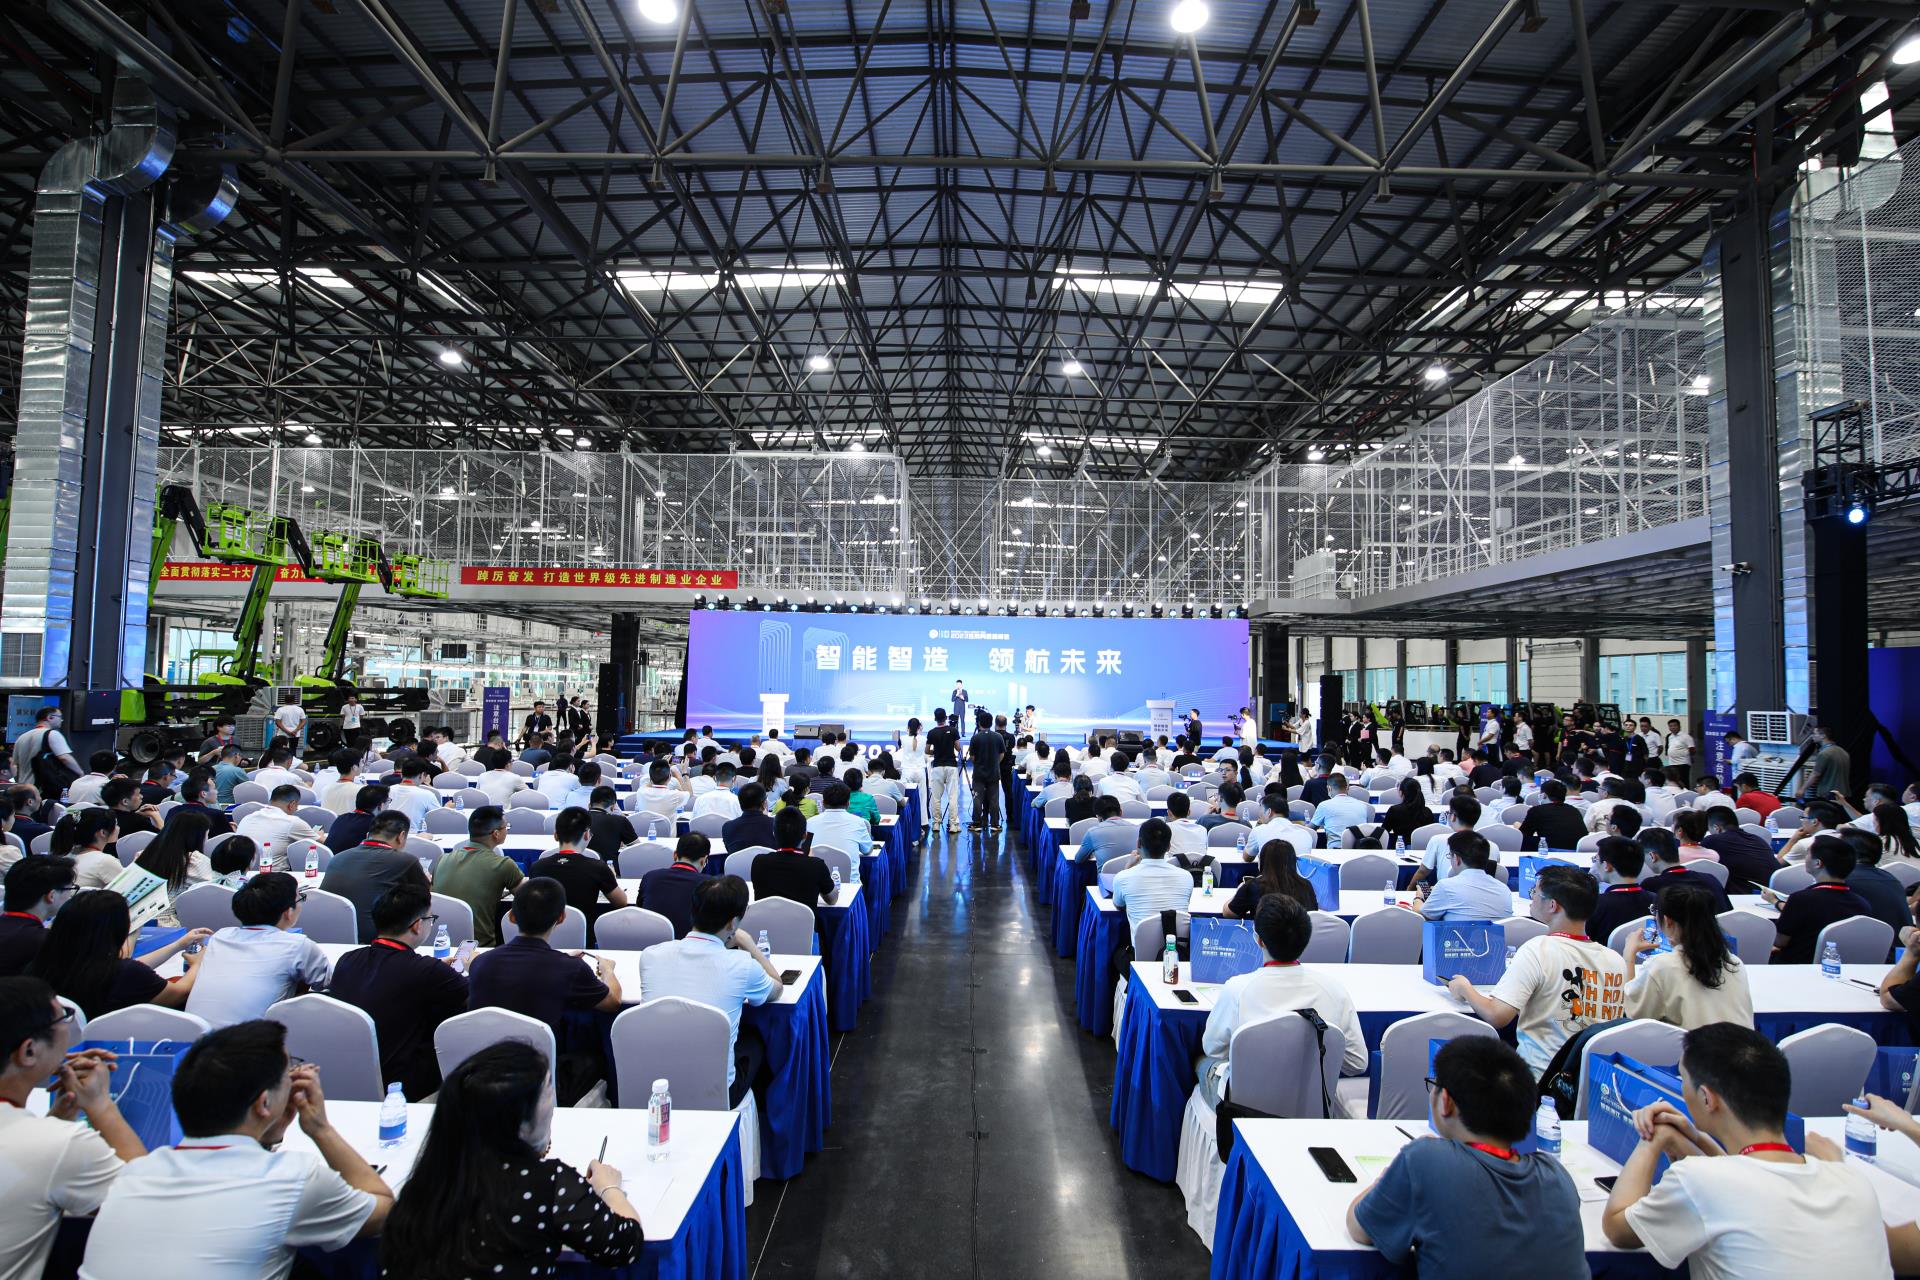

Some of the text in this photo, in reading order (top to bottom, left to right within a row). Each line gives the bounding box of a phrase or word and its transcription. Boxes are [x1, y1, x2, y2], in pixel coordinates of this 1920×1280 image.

[160, 566, 255, 578] 全面贯彻落实二十大
[477, 570, 722, 586] 踔厉奋发 打造世界级先进制造业企业
[815, 644, 1122, 675] 智能智造 领航未来
